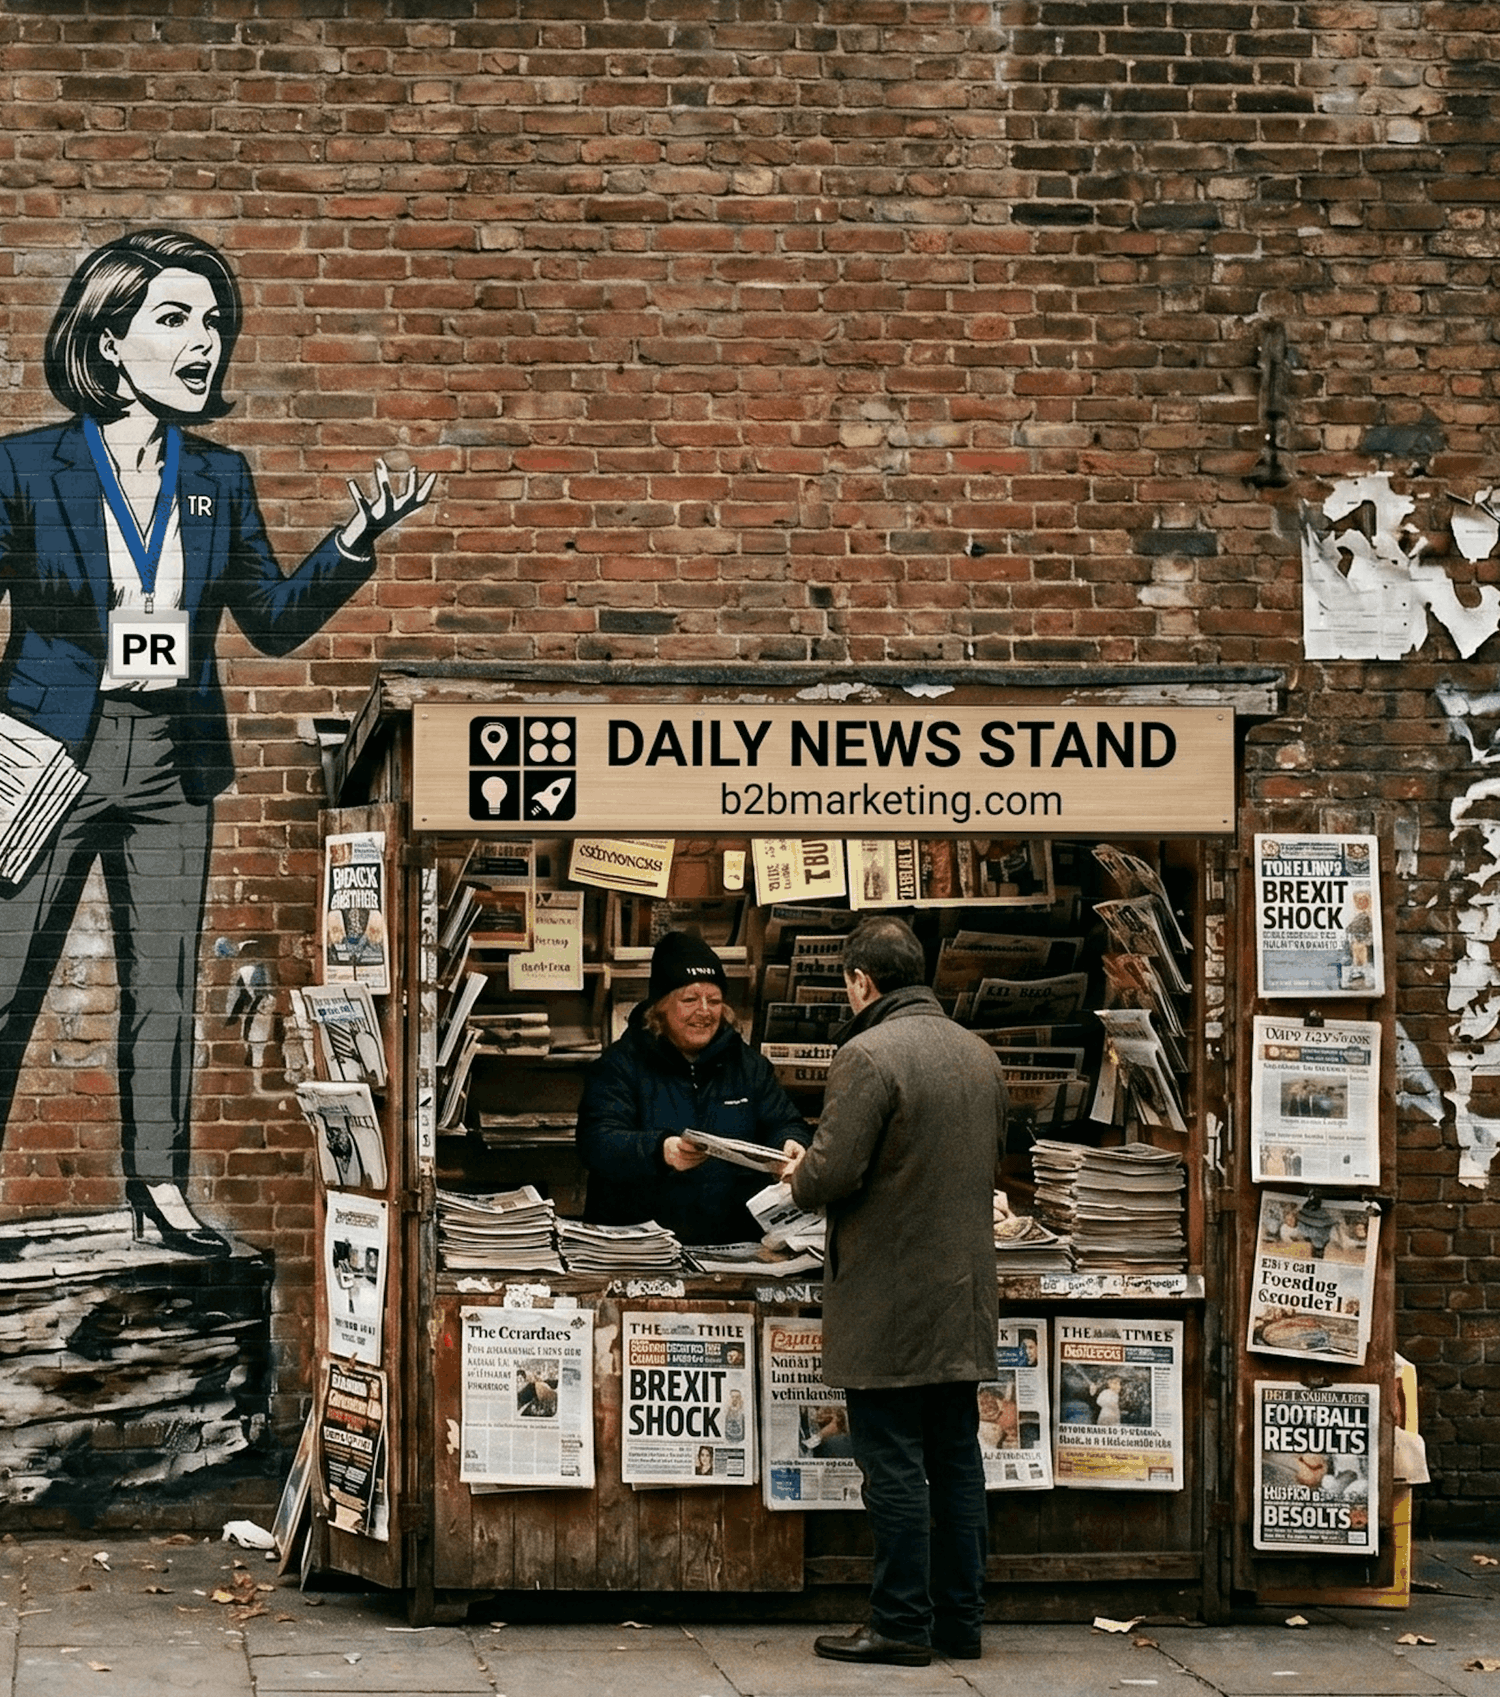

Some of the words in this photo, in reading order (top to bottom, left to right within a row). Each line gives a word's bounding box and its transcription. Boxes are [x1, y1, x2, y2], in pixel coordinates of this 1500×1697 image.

[122, 633, 177, 666] PR
[607, 719, 773, 767] DAILY
[791, 720, 962, 768] NEWS
[979, 720, 1178, 768] STAND
[721, 782, 1063, 823] b2bmarketing.com
[1262, 880, 1349, 904] BREXIT
[1263, 906, 1344, 930] SHOCK
[467, 1325, 496, 1339] The
[629, 1323, 662, 1336] THE
[1062, 1326, 1092, 1339] THE
[630, 1369, 727, 1403] BREXIT
[628, 1404, 722, 1438] SHOCK
[1264, 1403, 1367, 1429] FOOTBALL
[1264, 1426, 1366, 1454] RESULTS
